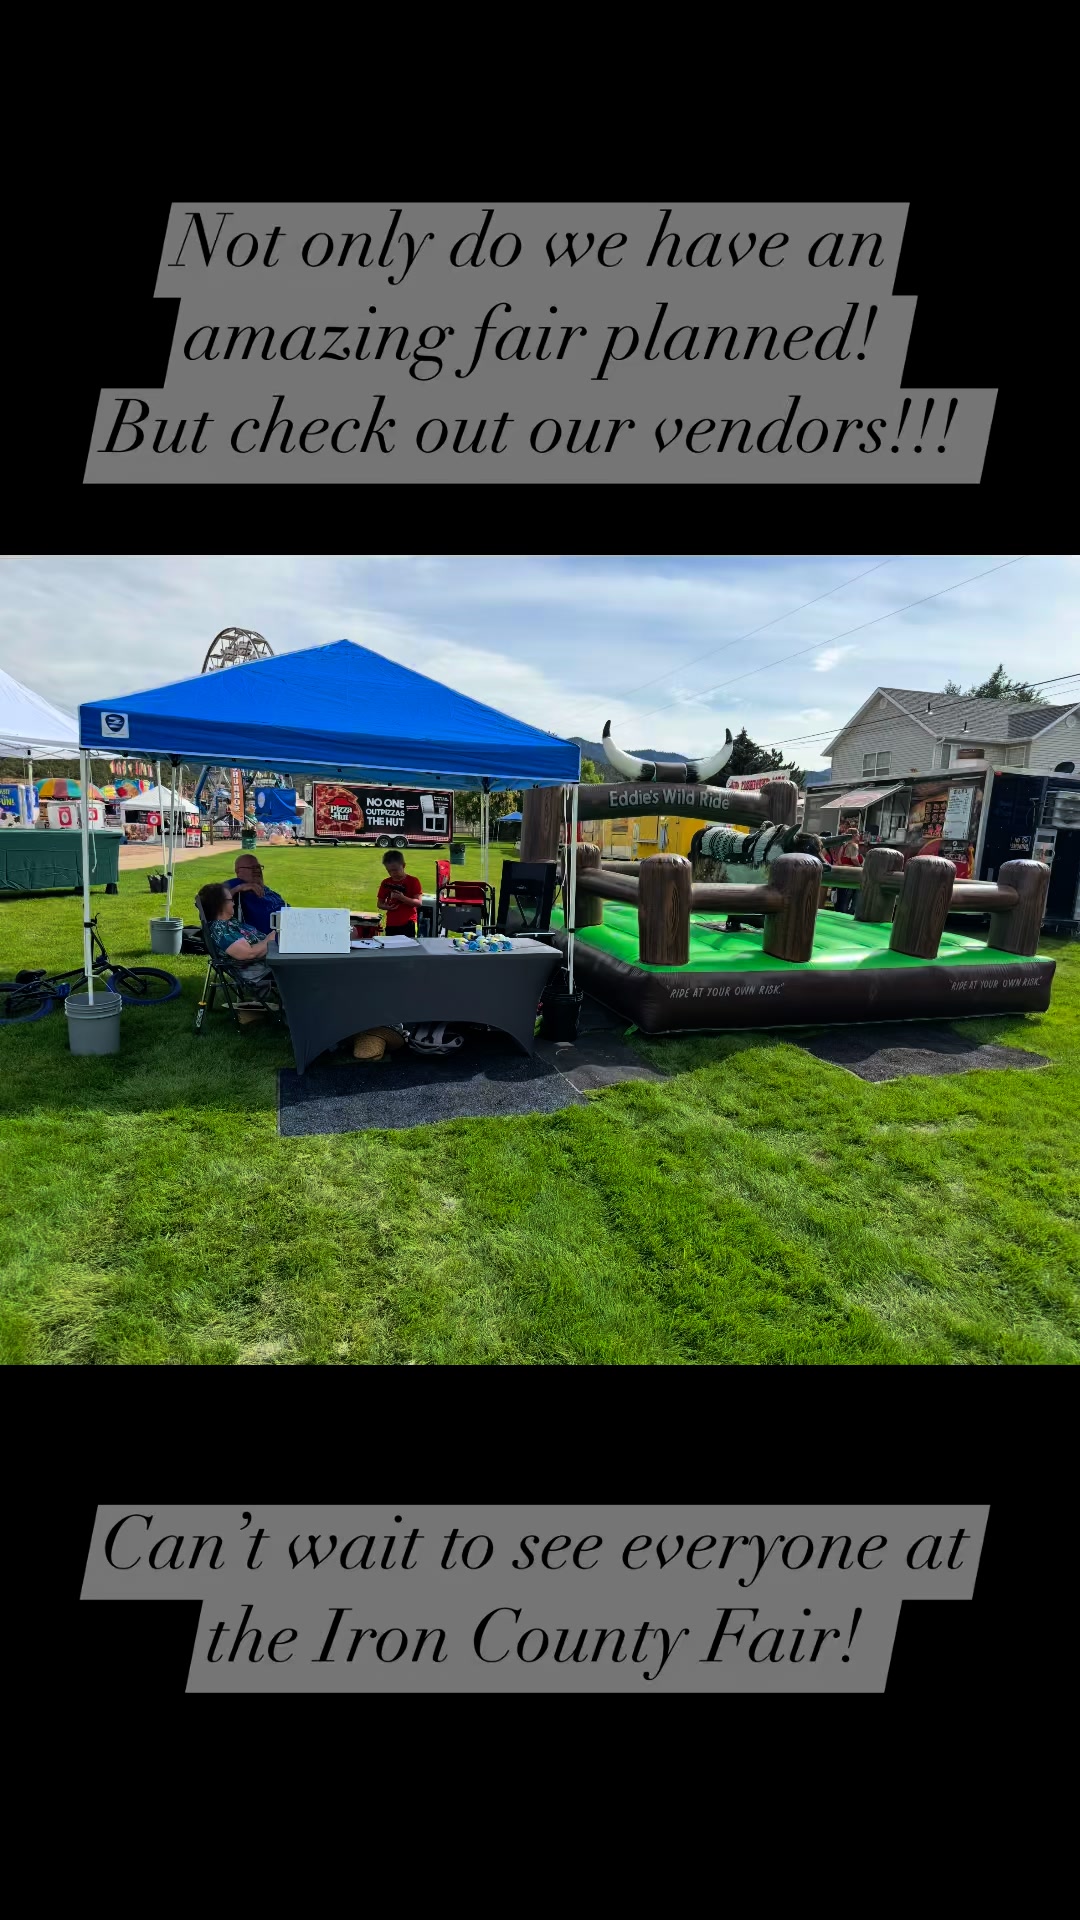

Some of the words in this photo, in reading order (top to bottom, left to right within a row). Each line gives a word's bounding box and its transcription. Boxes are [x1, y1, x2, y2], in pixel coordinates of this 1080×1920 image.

[366, 797, 383, 807] NO
[383, 799, 405, 808] ONE
[609, 788, 660, 807] Eddie's
[662, 788, 695, 805] Wild
[700, 793, 730, 810] Ride
[330, 804, 353, 814] Pizza
[365, 808, 405, 817] OUTPIZZAS
[330, 811, 349, 821] Hut
[366, 816, 385, 826] THE
[969, 980, 979, 990] AT
[980, 979, 999, 990] YOUR
[1002, 979, 1021, 988] OWN
[692, 987, 704, 998] AT
[706, 986, 731, 997] YOUR
[734, 985, 755, 996] OWN
